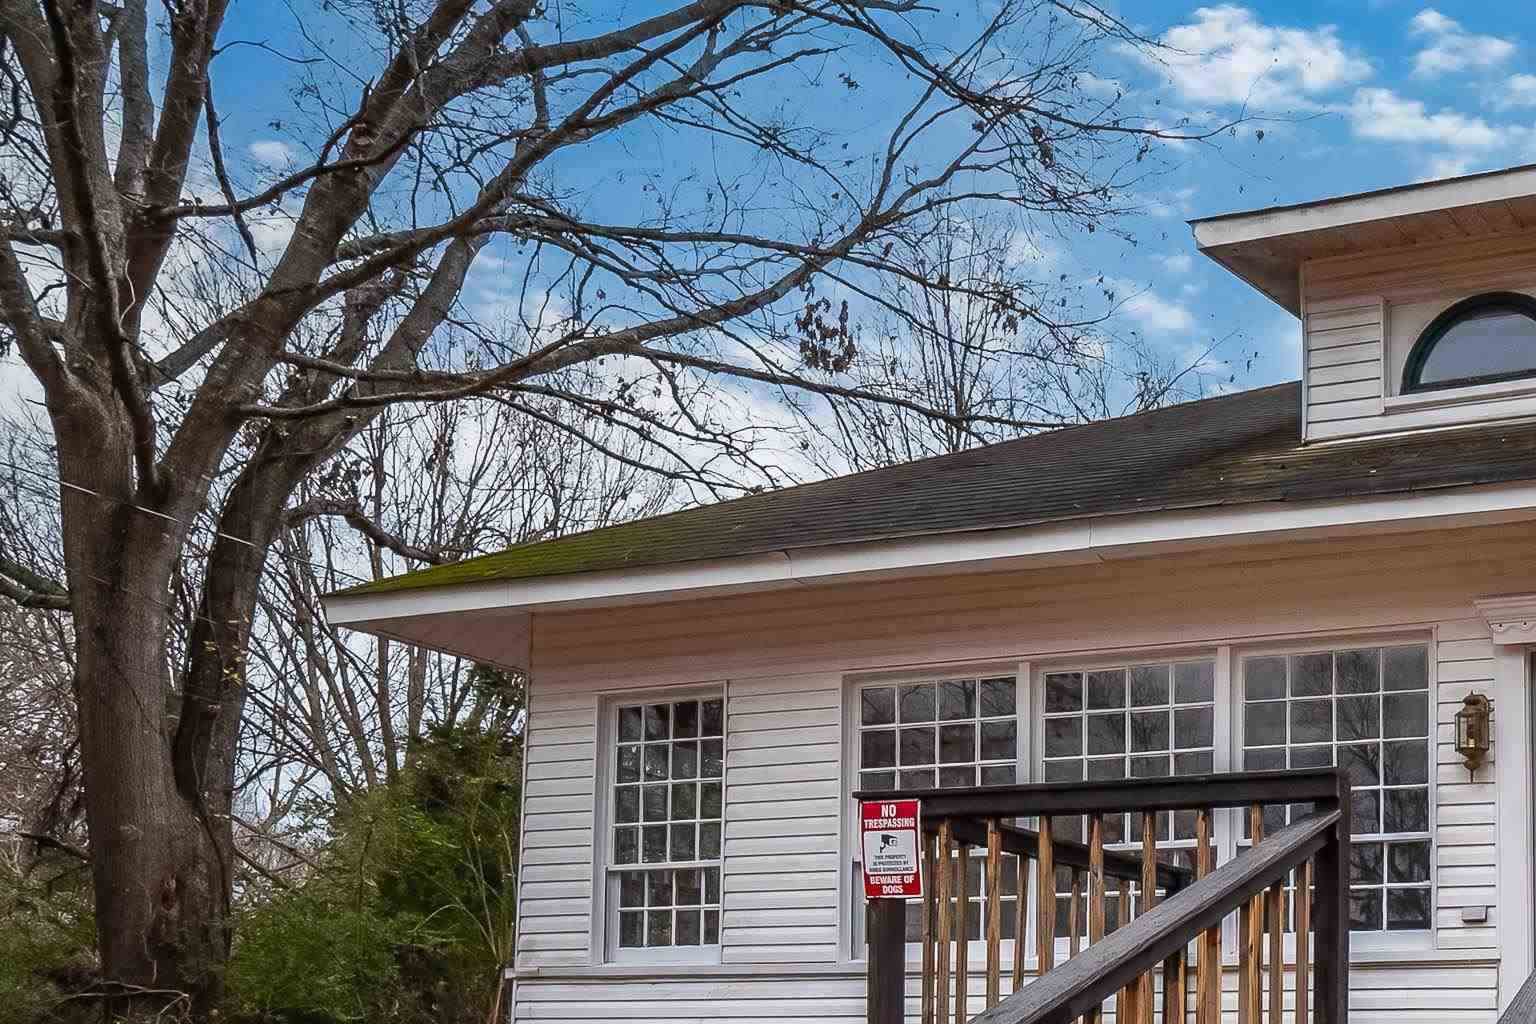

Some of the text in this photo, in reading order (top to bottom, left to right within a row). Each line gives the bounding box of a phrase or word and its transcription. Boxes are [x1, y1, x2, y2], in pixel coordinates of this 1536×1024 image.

[881, 804, 897, 818] NO
[864, 817, 915, 829] TRESPASSING
[870, 874, 915, 885] BEWARE OF
[882, 885, 904, 894] DOGS
